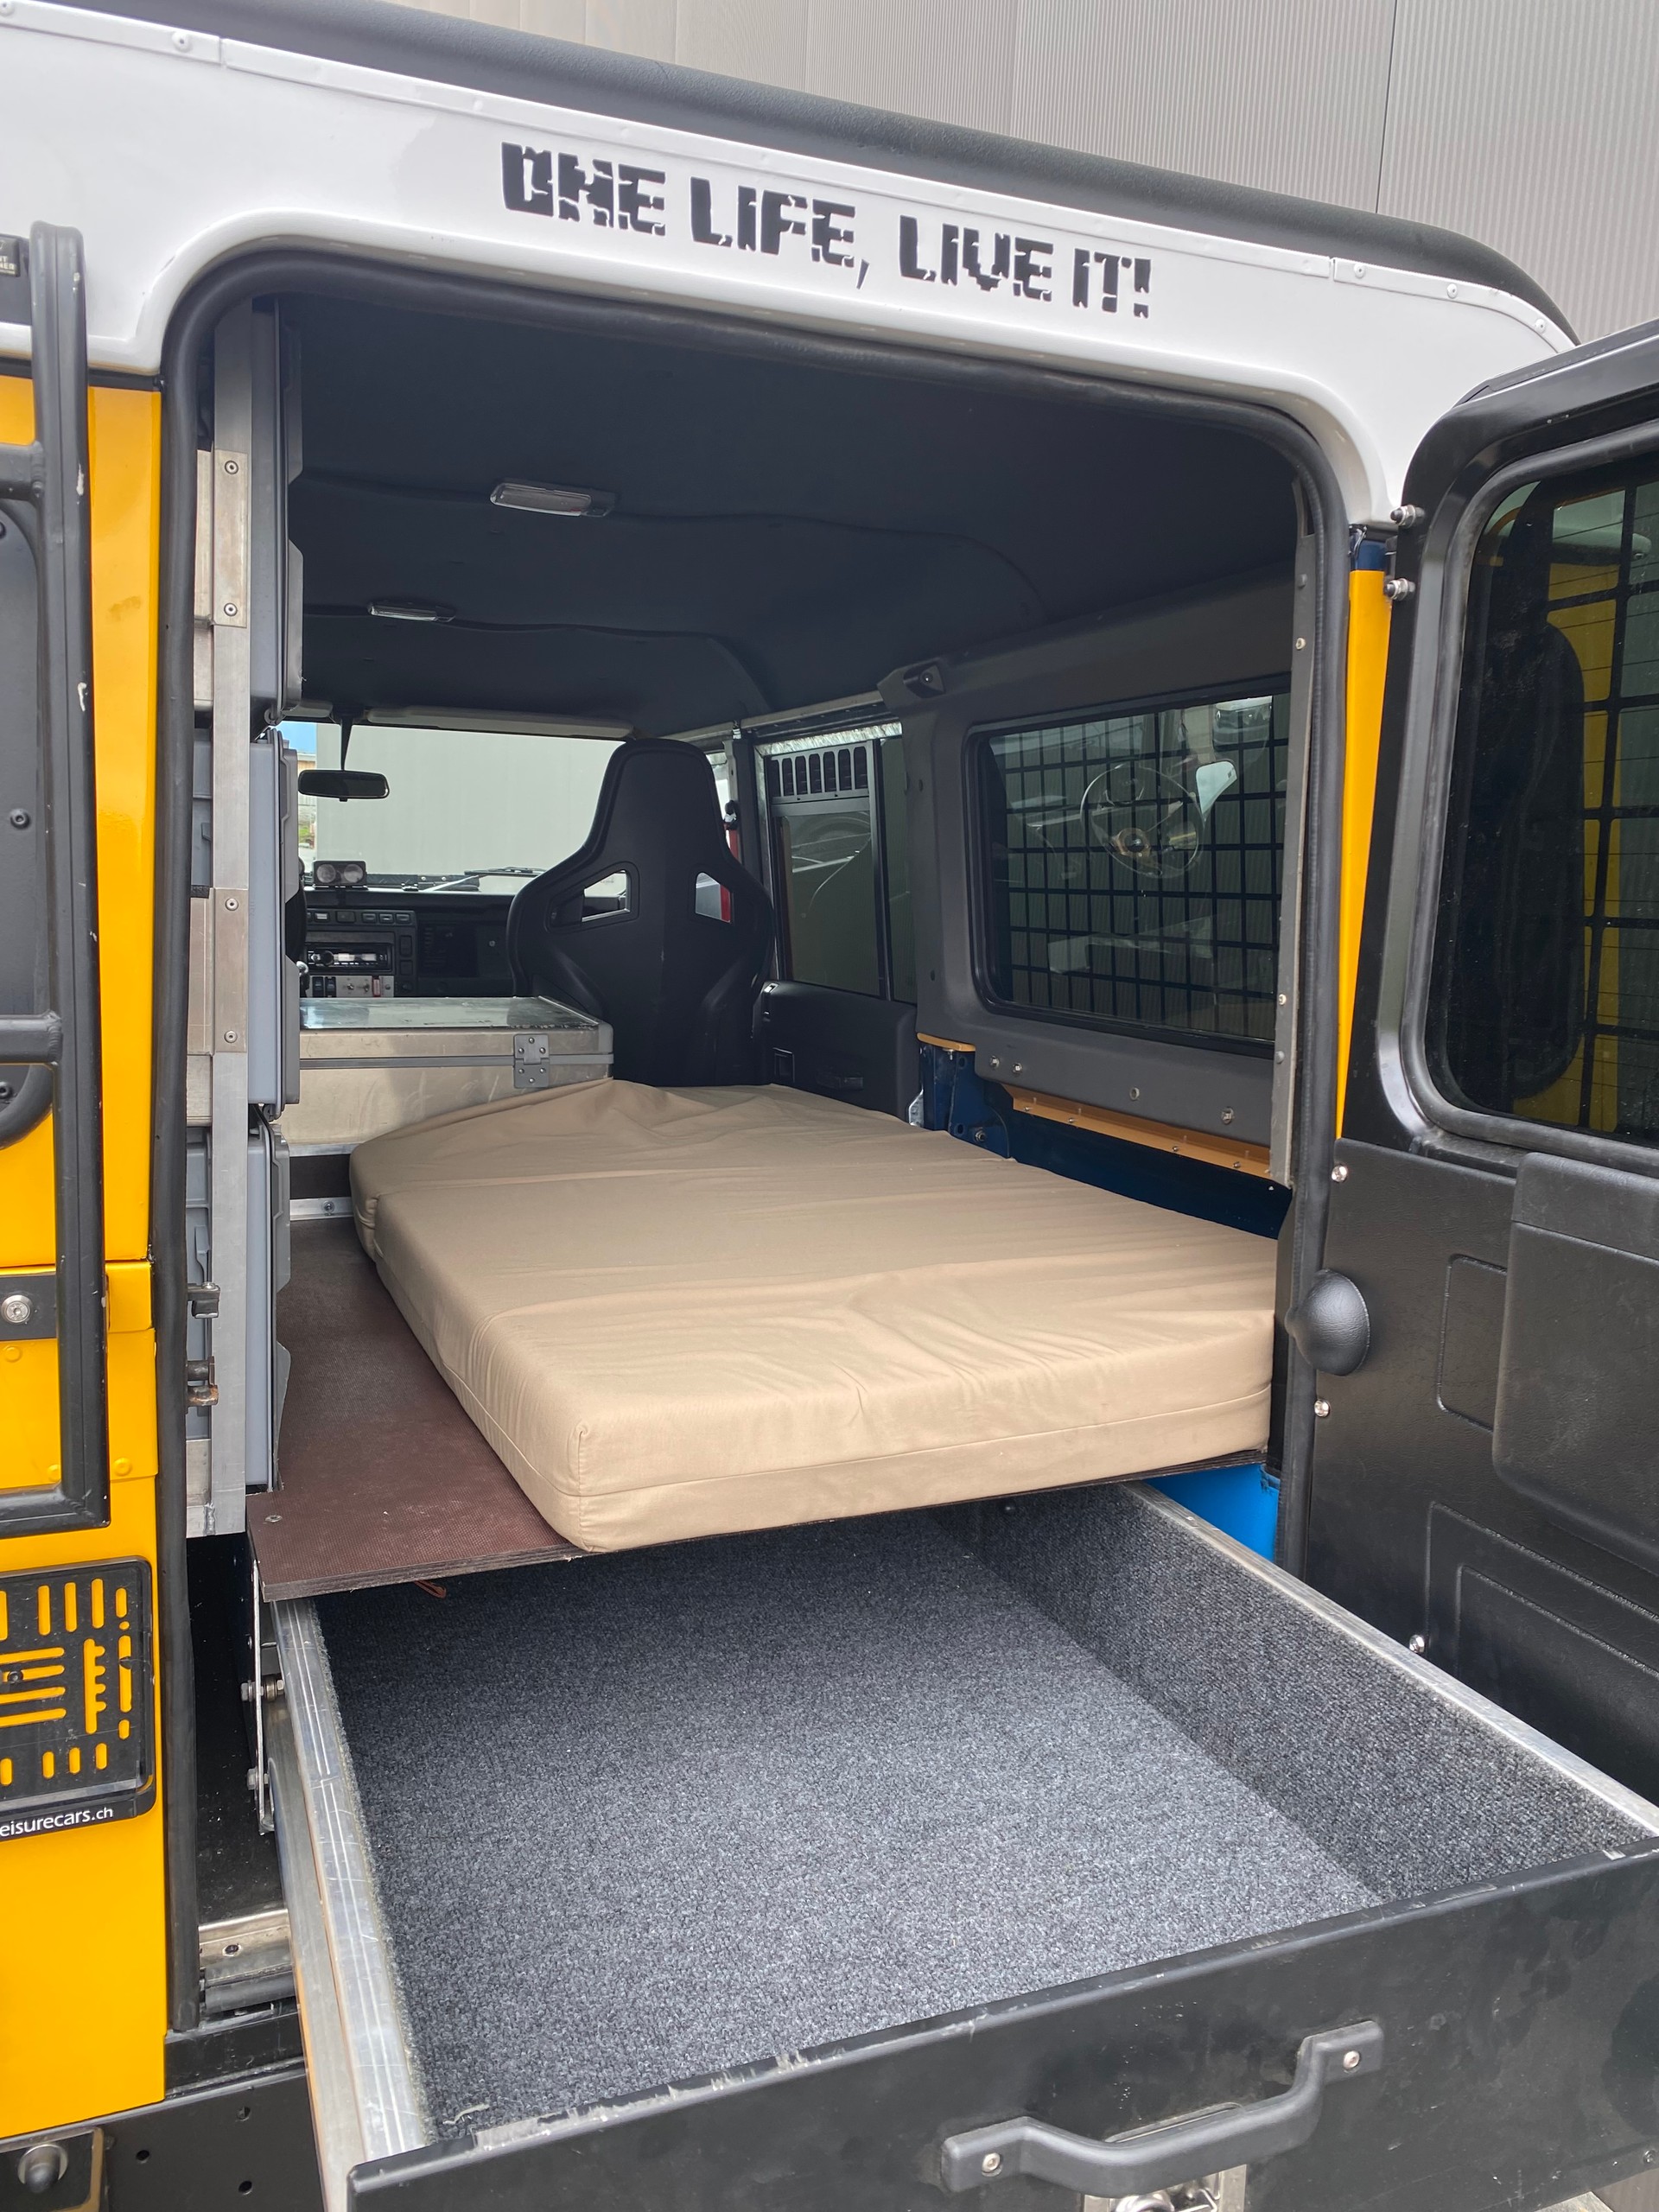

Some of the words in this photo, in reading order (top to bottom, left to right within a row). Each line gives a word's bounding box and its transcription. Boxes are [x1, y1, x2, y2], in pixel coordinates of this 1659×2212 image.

[502, 142, 666, 236] ONE
[690, 177, 871, 290] LIFE,
[899, 216, 1054, 302] LIVE
[1072, 248, 1152, 320] IT!
